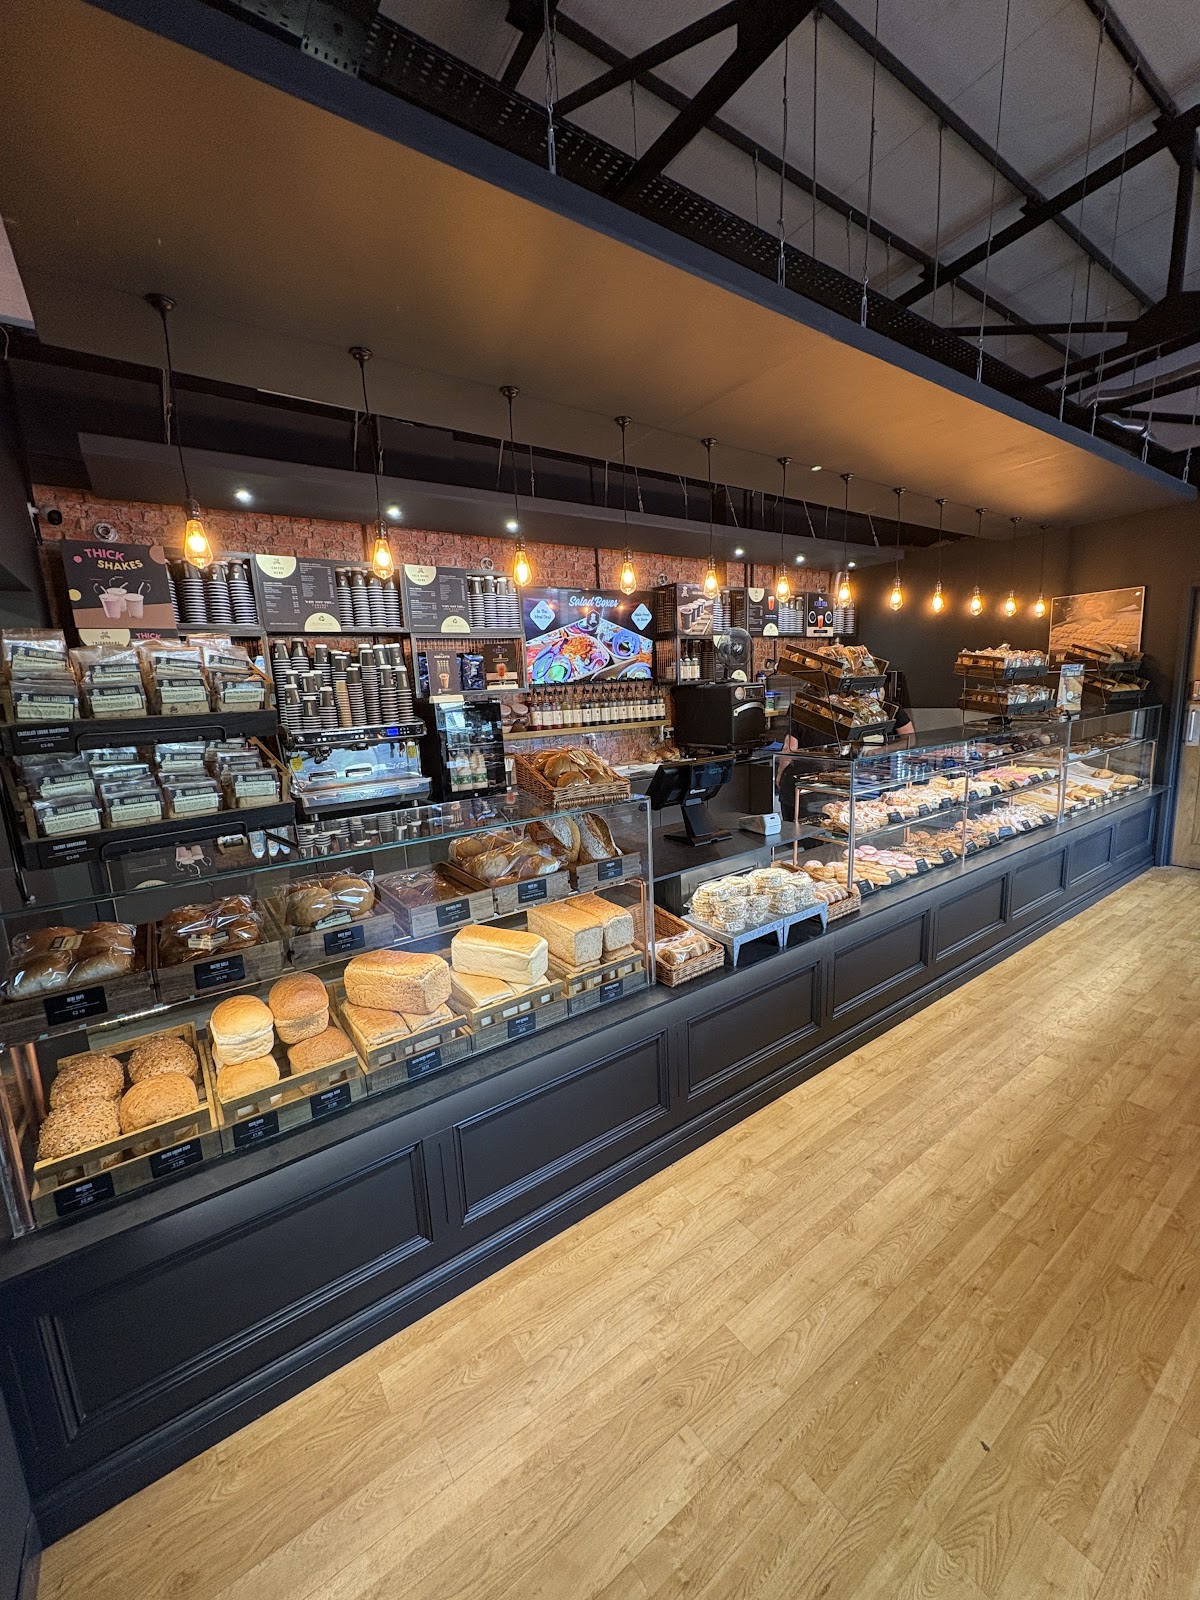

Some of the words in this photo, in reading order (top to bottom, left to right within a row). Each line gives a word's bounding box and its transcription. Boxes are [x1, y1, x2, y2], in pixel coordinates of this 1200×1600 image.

[84, 548, 125, 562] THICK
[97, 560, 144, 571] SHAKES
[568, 596, 594, 607] Salad
[594, 596, 619, 608] Boxes
[136, 632, 162, 641] THICK
